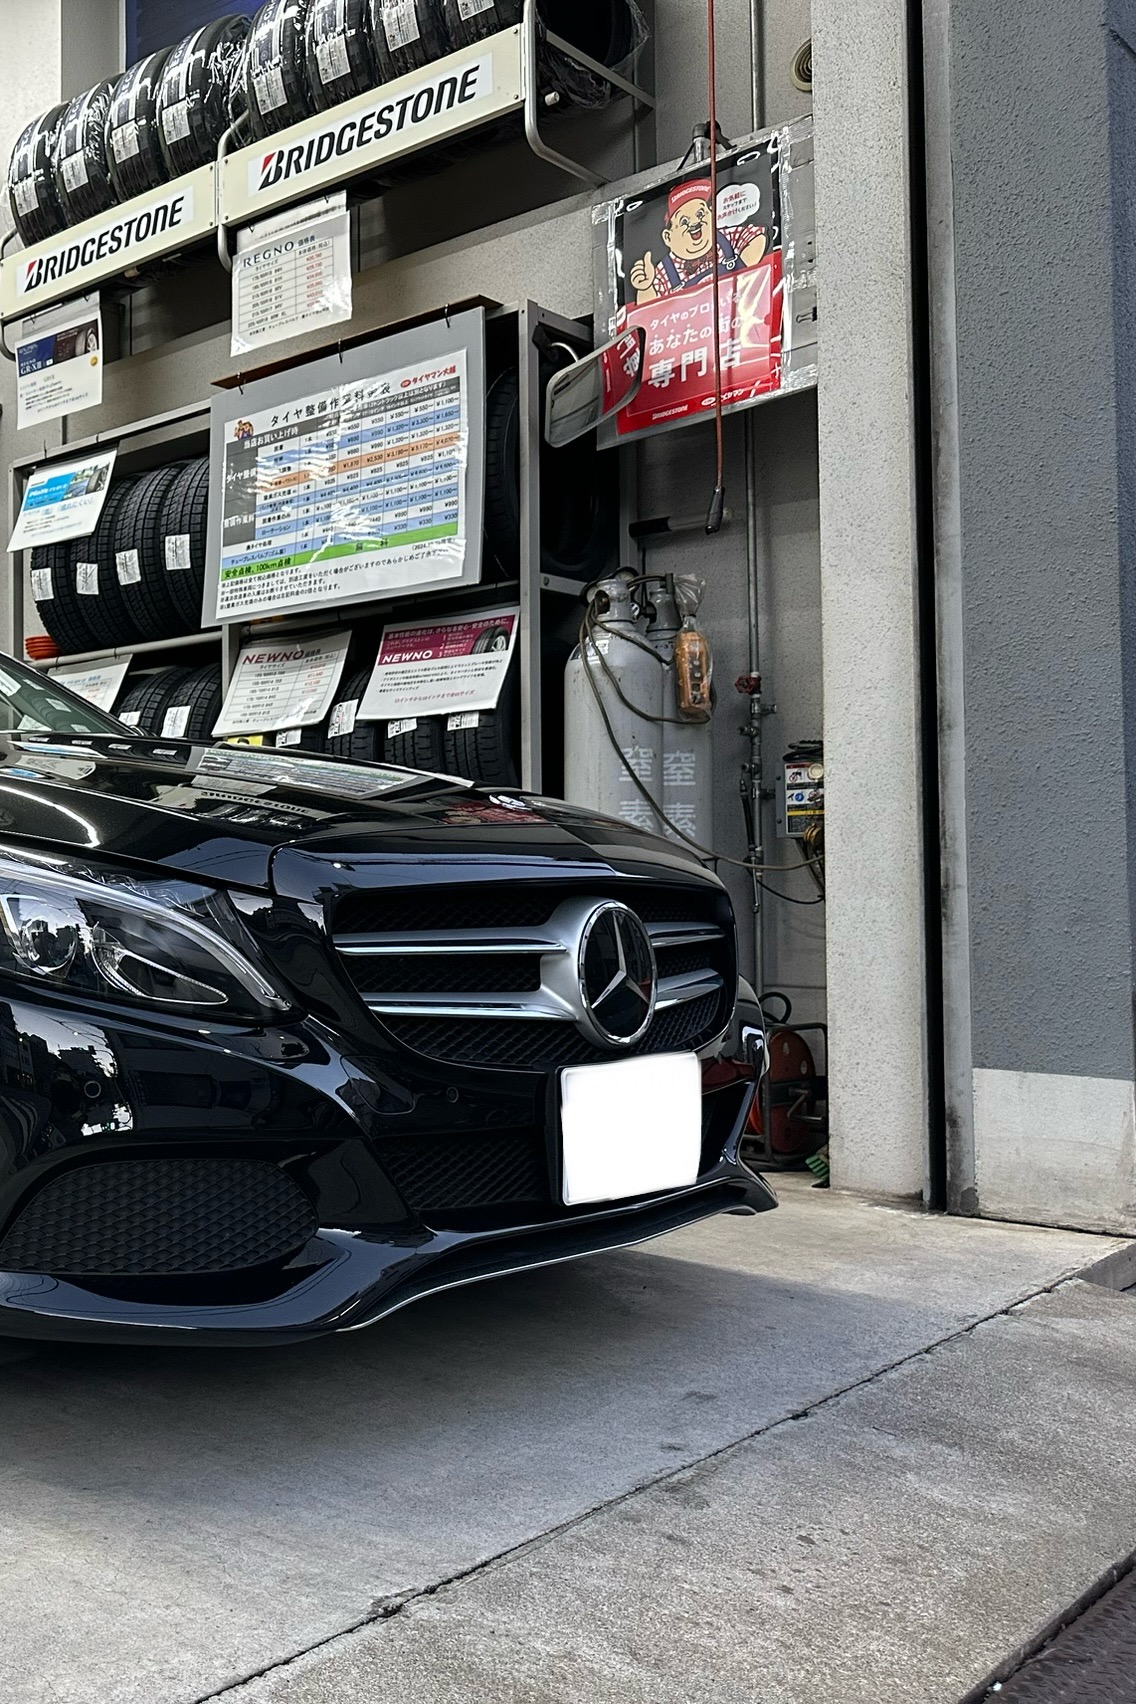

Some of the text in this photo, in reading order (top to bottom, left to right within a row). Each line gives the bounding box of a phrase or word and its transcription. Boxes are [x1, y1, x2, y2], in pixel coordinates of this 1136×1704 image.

[257, 64, 480, 191] BRIDGESTONE
[24, 196, 185, 293] BRIDGESTONE
[243, 239, 294, 268] REGNO
[650, 291, 742, 331] タイヤのプロいる
[241, 649, 305, 665] NEWNO
[380, 649, 434, 664] NEWNO
